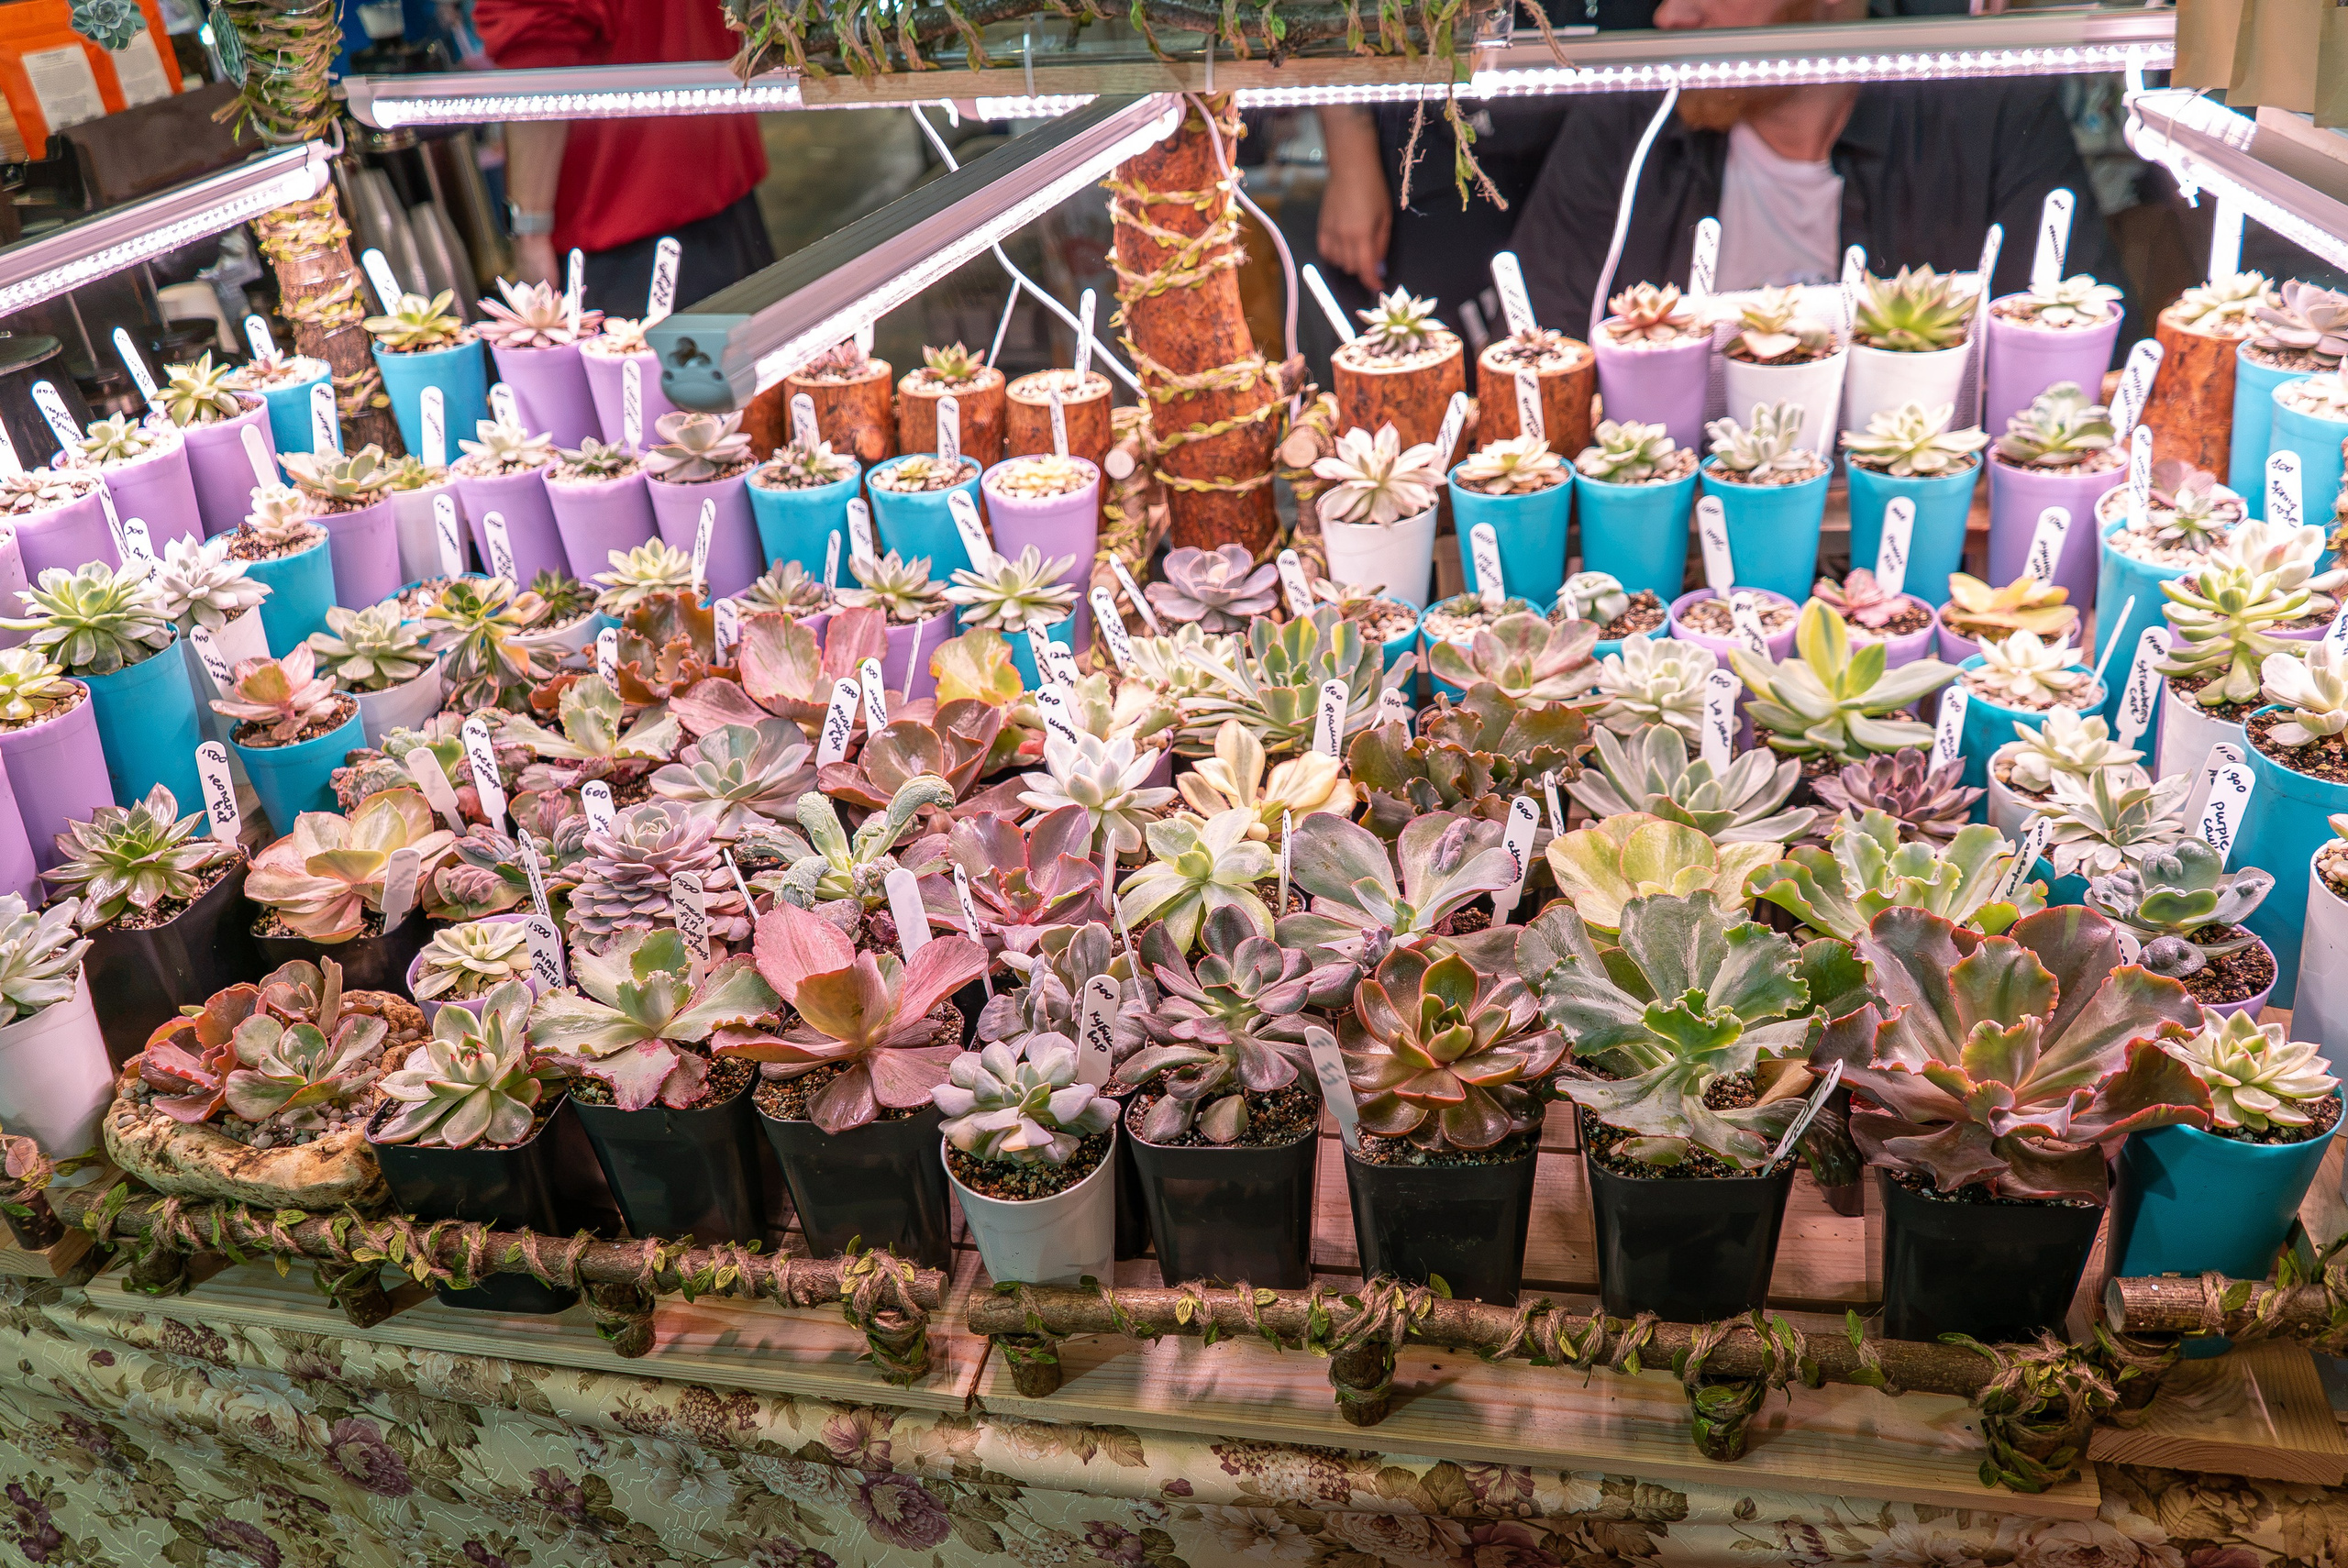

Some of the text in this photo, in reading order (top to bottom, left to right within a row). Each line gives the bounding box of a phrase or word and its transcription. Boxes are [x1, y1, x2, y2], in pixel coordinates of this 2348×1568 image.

[1037, 692, 1060, 706] 800
[1324, 685, 1344, 701] 800
[465, 726, 488, 739] 1900
[201, 748, 228, 764] 1500
[2215, 745, 2238, 764] 110
[584, 787, 609, 800] 600
[1515, 801, 1534, 821] 900
[2037, 821, 2045, 846] 900
[2210, 801, 2231, 852] purple
[672, 876, 701, 895] 1500
[527, 920, 552, 940] 1500
[532, 948, 559, 977] pink
[1091, 981, 1115, 1000] 700
